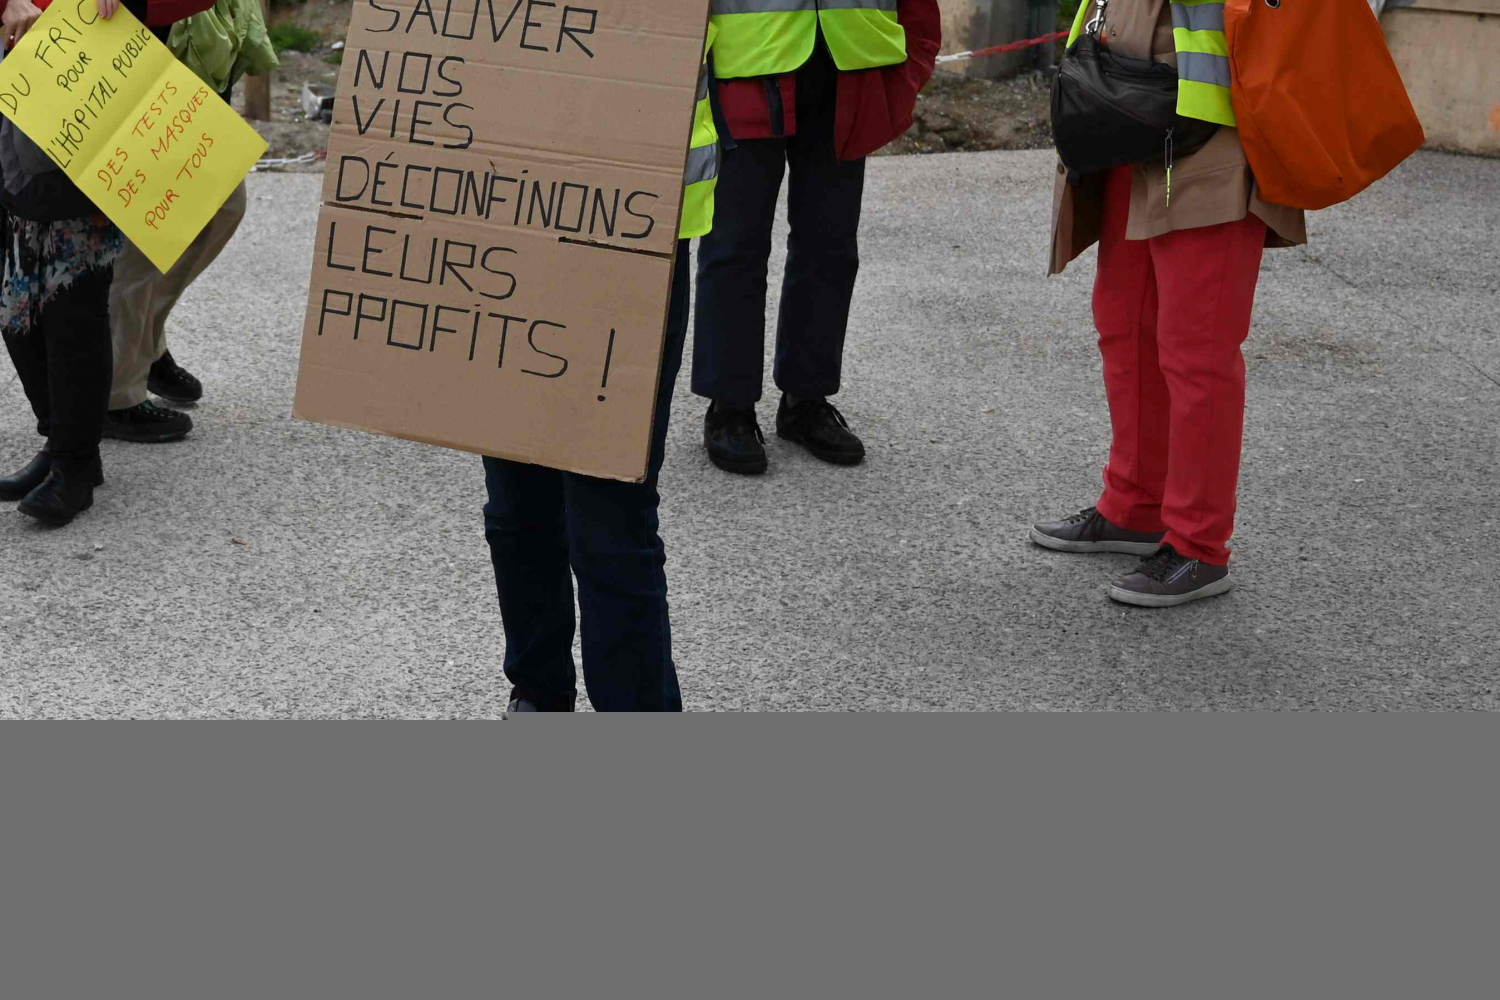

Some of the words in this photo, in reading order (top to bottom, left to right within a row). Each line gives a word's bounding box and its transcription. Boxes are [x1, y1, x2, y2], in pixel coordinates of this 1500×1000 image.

[47, 74, 118, 169] L'HÔPITAL
[112, 28, 151, 78] PUBLIC
[56, 50, 93, 92] POUR
[354, 49, 465, 97] NOS
[97, 147, 129, 191] DES
[131, 81, 178, 138] TESTS
[117, 169, 147, 208] DES
[150, 86, 210, 161] MASQUES
[351, 95, 474, 149] VIES
[144, 188, 180, 230] POUR
[175, 132, 214, 181] TOUS
[334, 151, 660, 239] DÉCONFINONS
[326, 221, 518, 300] LEURS
[597, 329, 616, 402] !
